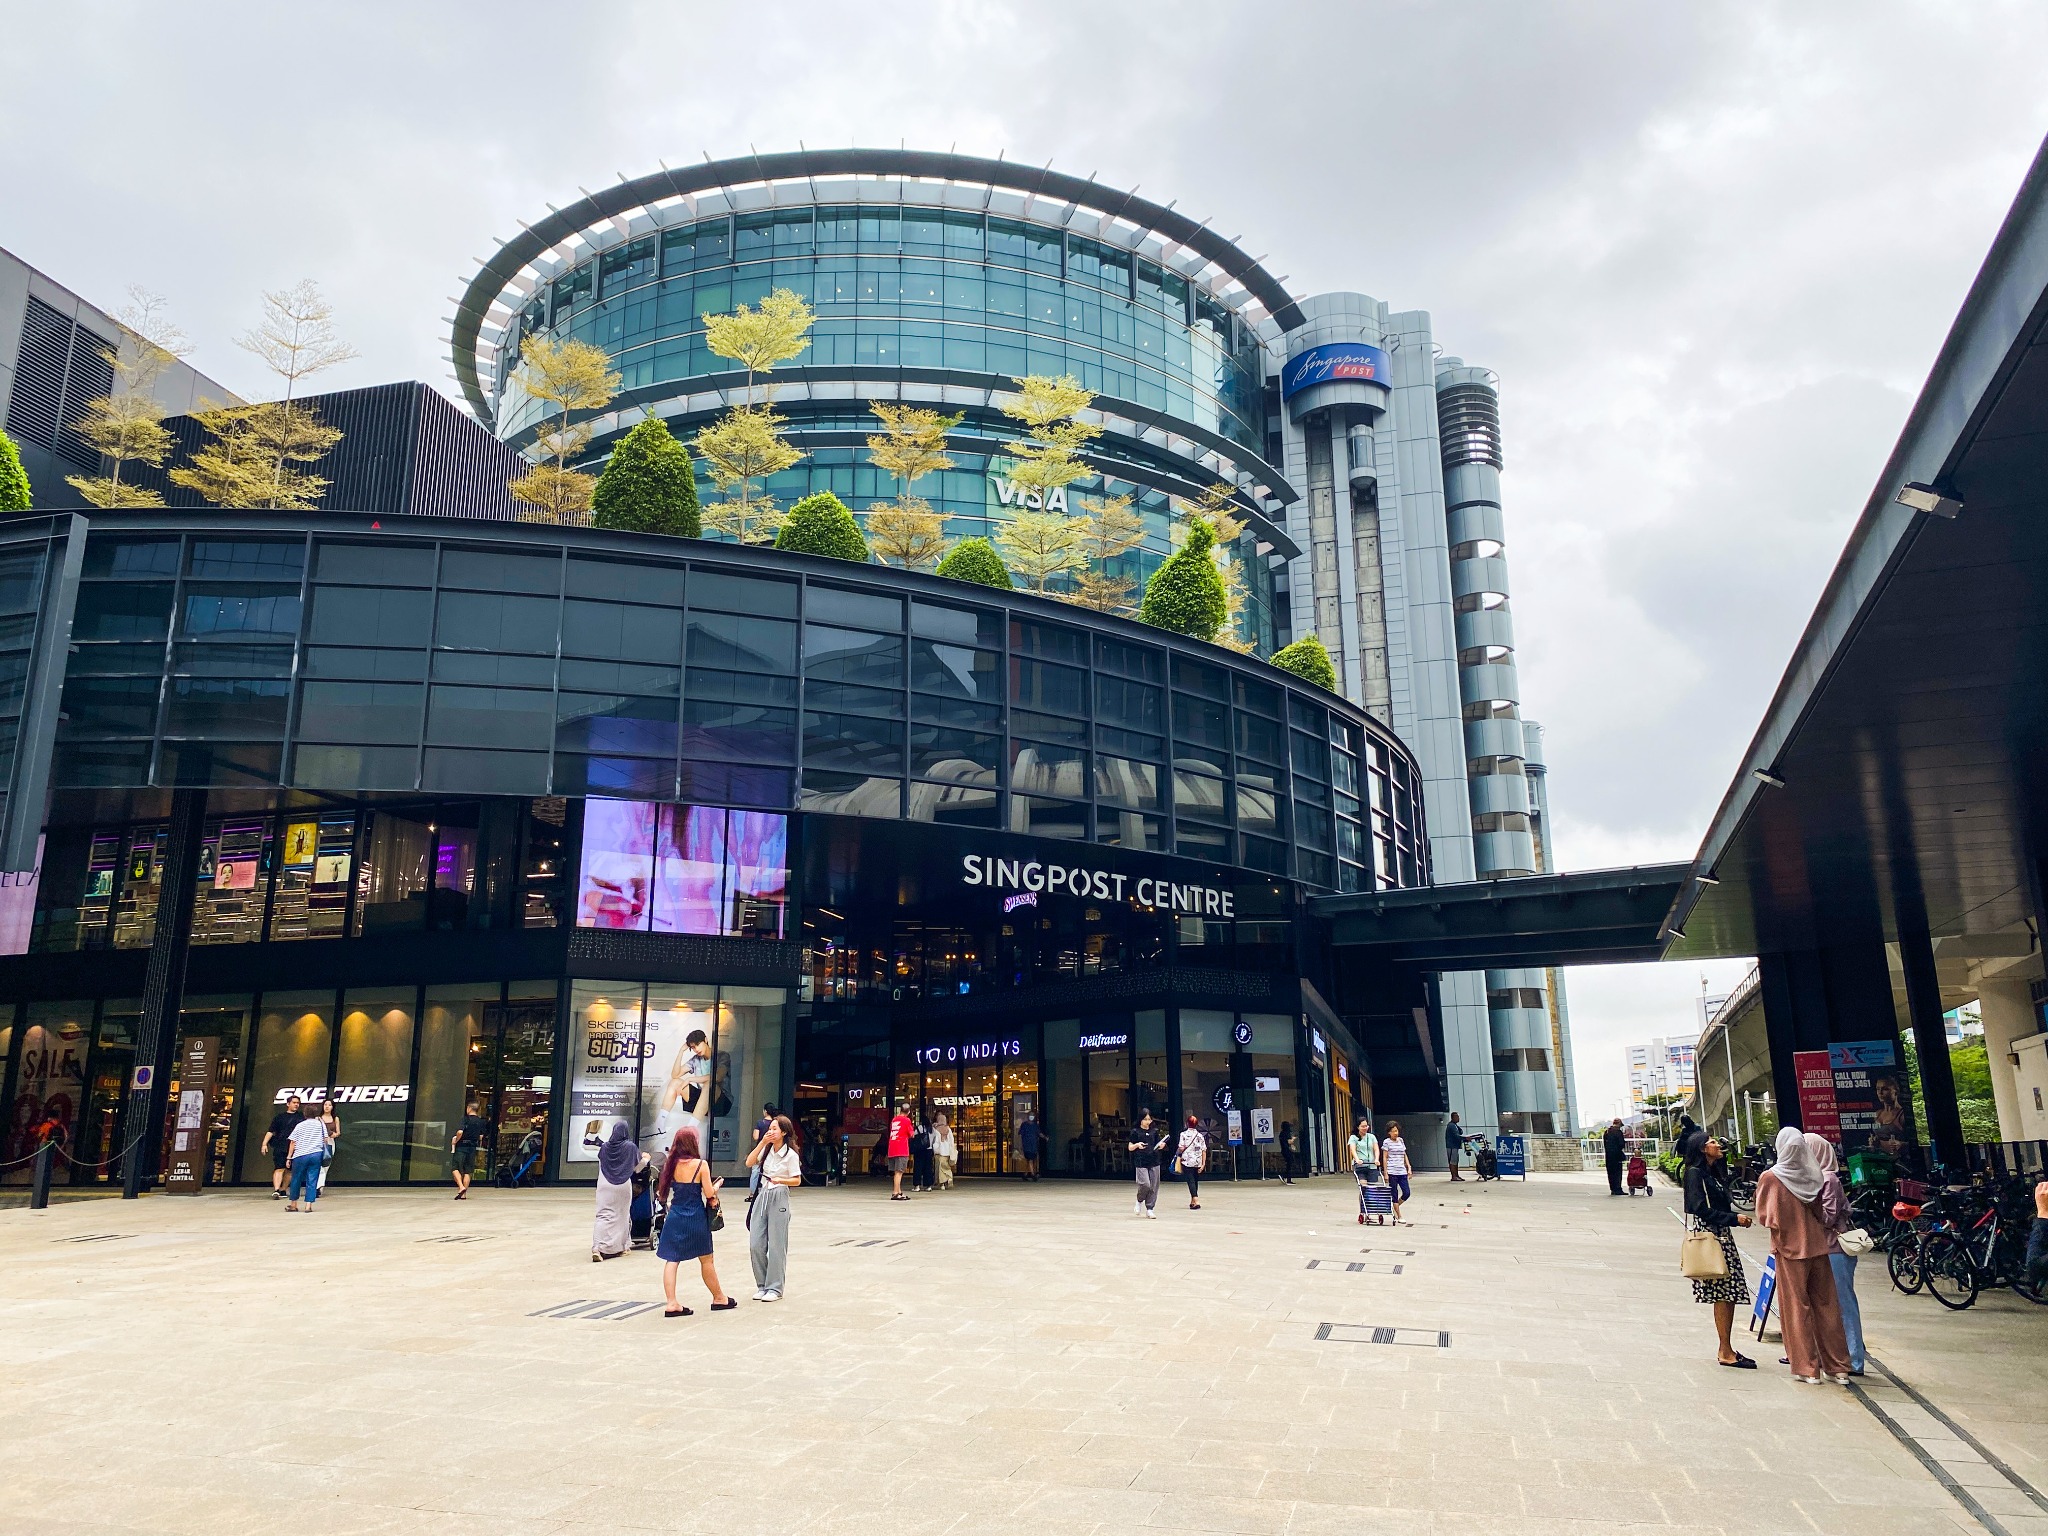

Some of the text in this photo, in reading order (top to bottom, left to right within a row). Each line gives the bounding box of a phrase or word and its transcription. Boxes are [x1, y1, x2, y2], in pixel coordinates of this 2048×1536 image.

[1292, 352, 1375, 386] Singapore
[1343, 367, 1372, 375] POST
[988, 476, 1069, 513] VISA
[963, 854, 1235, 918] SINGPOST CENTRE
[588, 1020, 659, 1031] SKECHERS
[1079, 1033, 1128, 1048] Délifrance
[24, 1048, 75, 1079] SALE
[586, 1066, 608, 1074] JUST
[610, 1066, 628, 1074] SLIP
[1835, 1071, 1867, 1080] CALL NOW
[273, 1085, 410, 1104] SKECHERS
